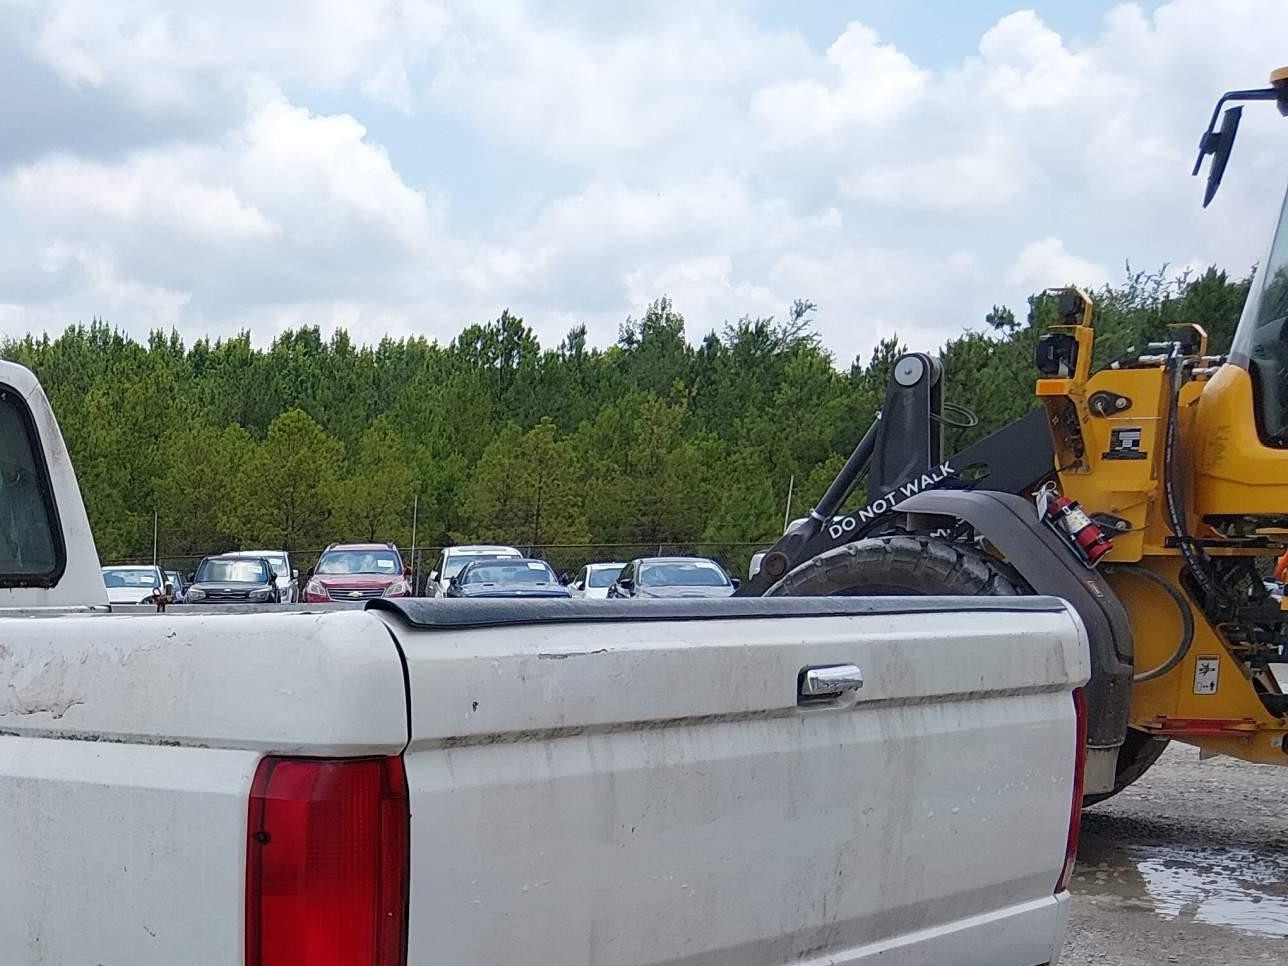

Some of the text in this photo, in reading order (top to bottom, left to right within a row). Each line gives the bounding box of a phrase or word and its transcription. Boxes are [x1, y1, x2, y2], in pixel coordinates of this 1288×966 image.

[828, 460, 955, 540] DO NOT WALK
